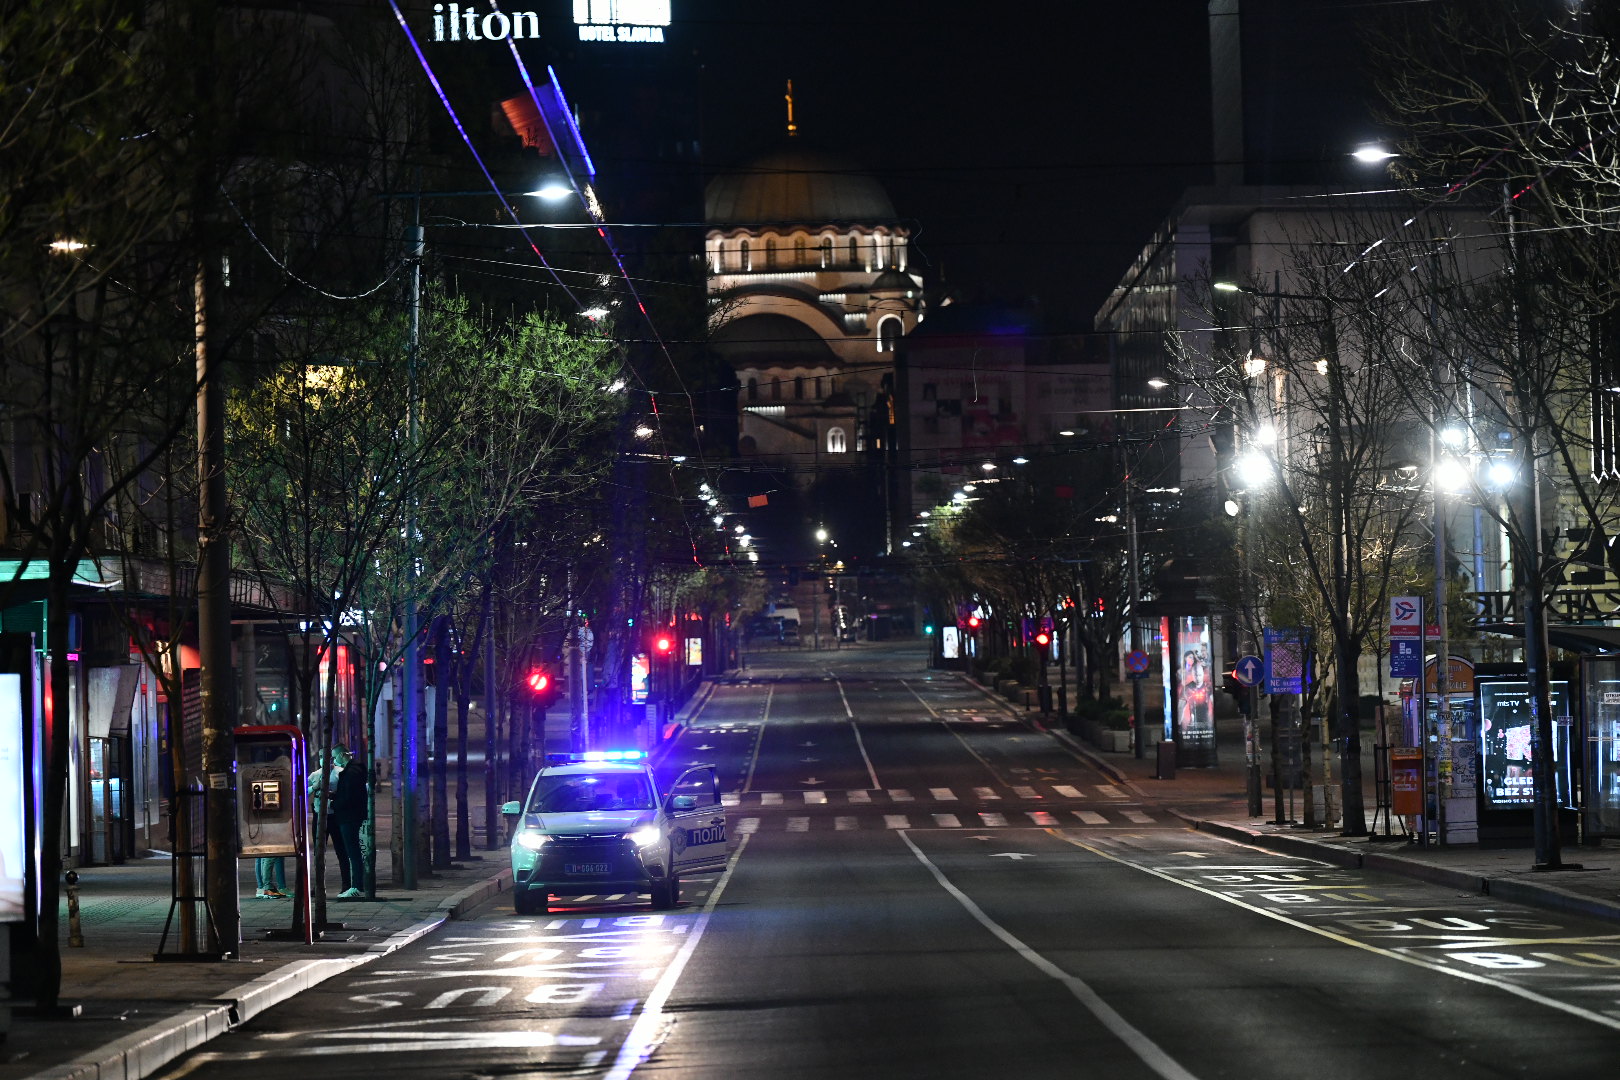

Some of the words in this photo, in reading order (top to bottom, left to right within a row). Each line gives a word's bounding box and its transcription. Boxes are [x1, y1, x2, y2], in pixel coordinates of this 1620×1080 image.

[579, 25, 615, 41] HOTEL
[1504, 777, 1533, 785] GLED
[1496, 788, 1519, 796] BEZ
[693, 826, 726, 844] ПОЛИ
[1199, 874, 1364, 882] BUS
[486, 914, 667, 931] BUS
[1334, 917, 1564, 931] BUS
[419, 946, 660, 965] BUS
[347, 983, 606, 1014] BUS
